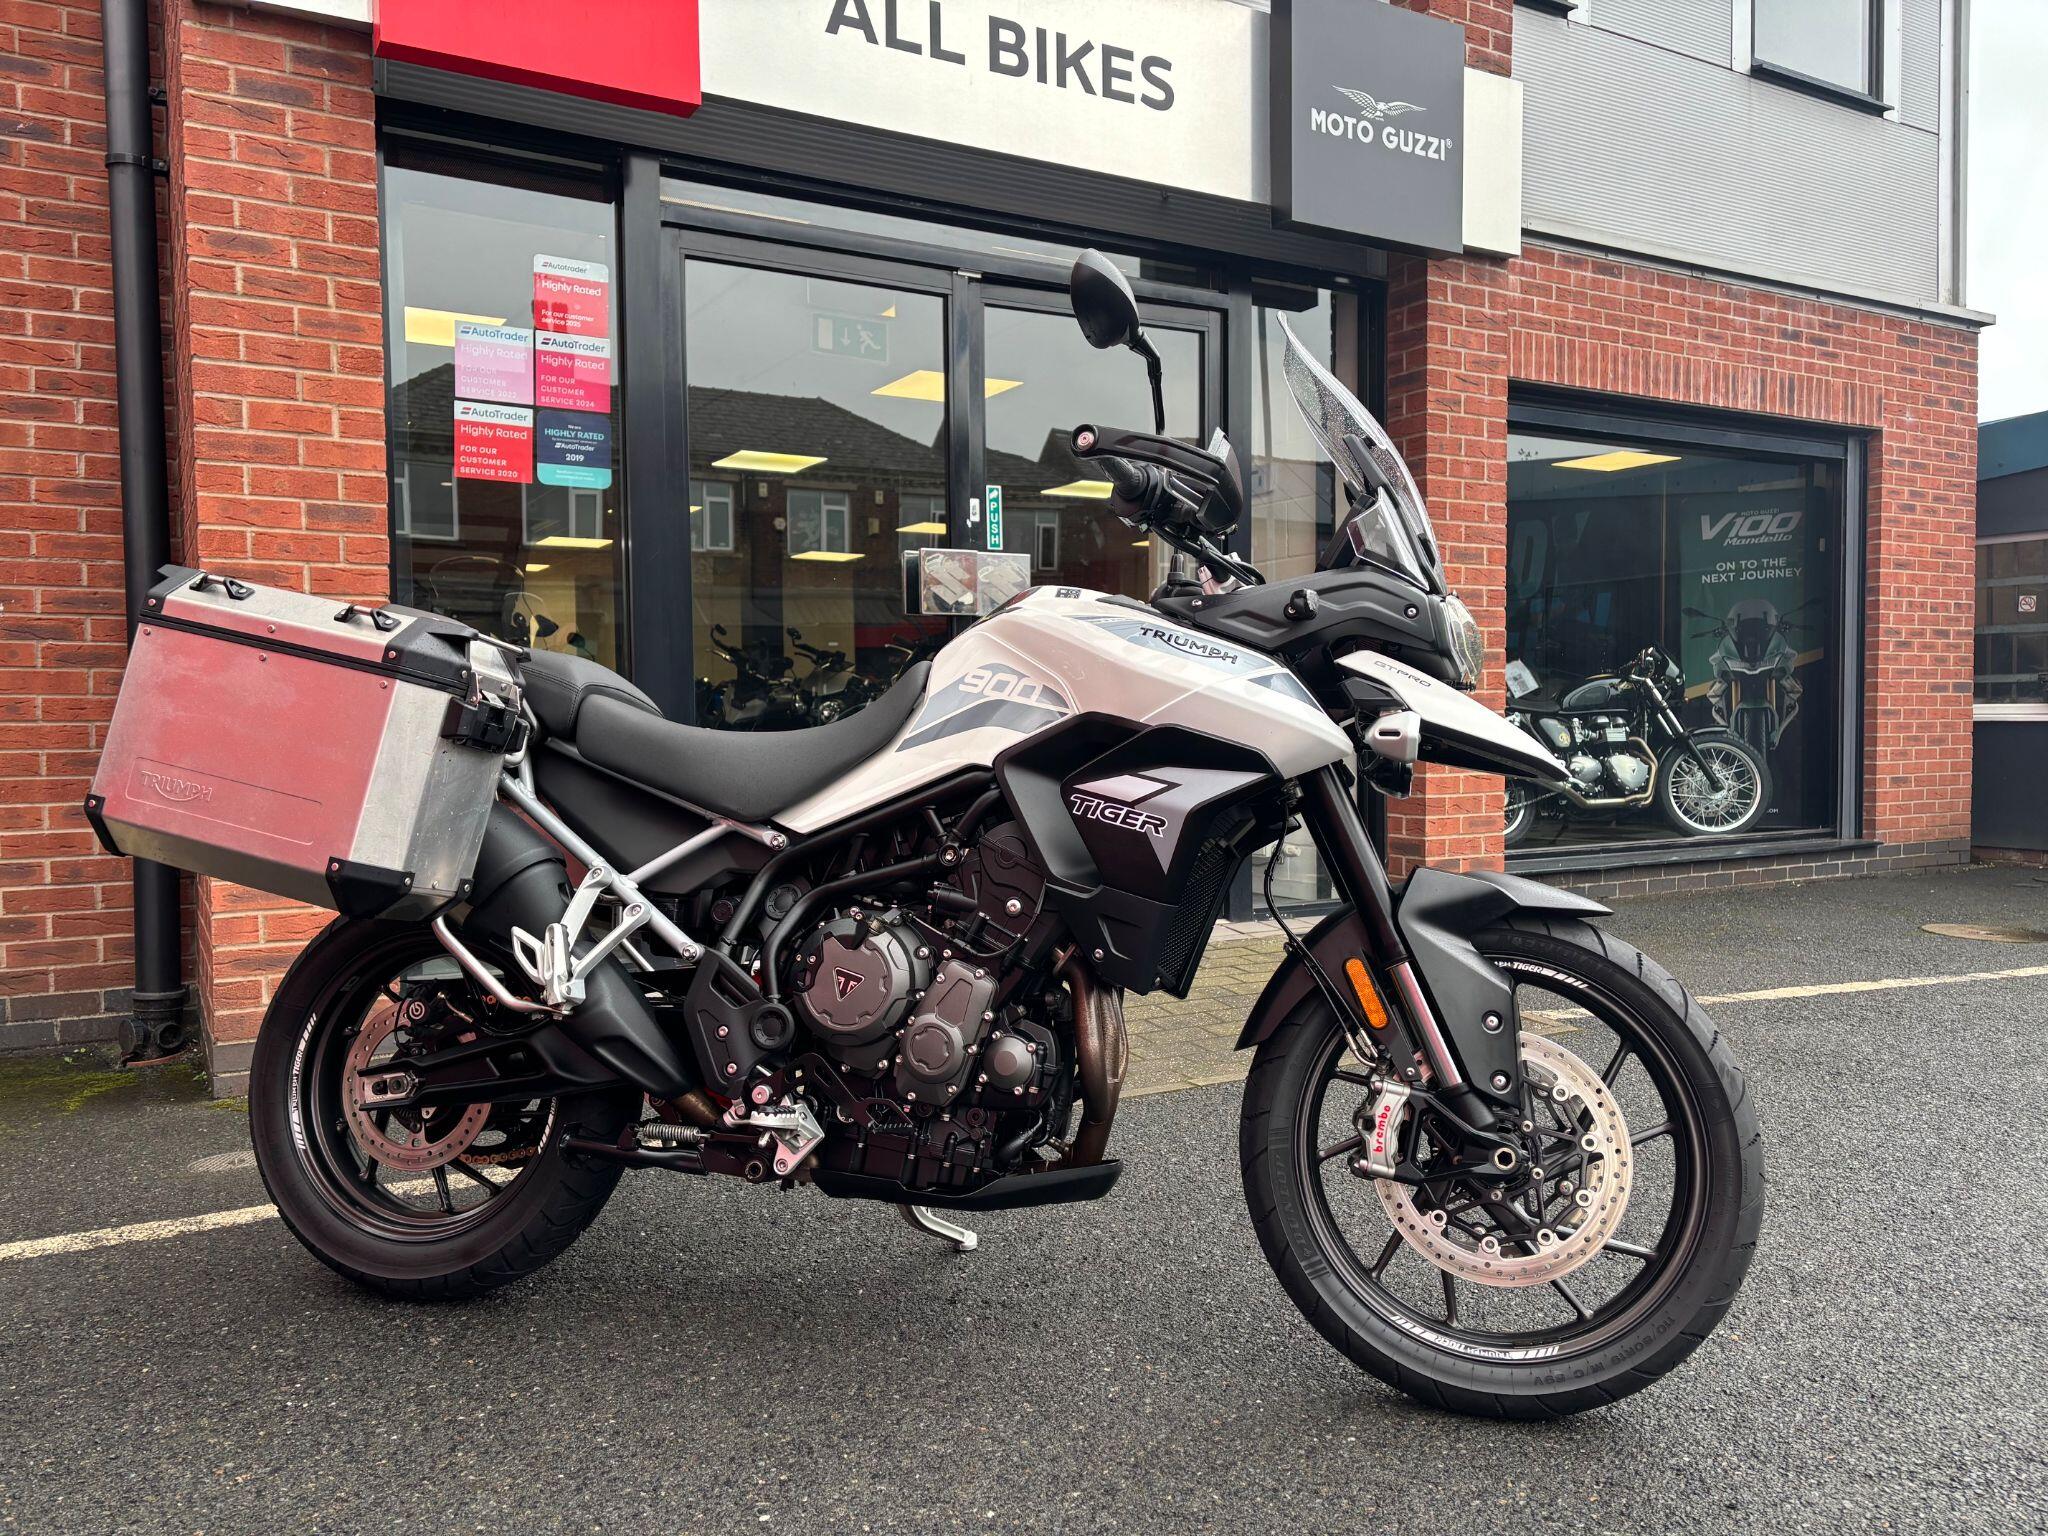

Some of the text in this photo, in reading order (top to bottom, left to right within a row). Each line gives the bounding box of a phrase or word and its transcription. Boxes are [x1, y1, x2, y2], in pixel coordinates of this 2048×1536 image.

[825, 0, 1175, 111] ALL BIKES
[1311, 107, 1374, 143] MOTO
[548, 262, 587, 274] Autotrader
[541, 280, 602, 297] Highly Rated
[541, 317, 566, 326] service
[564, 313, 594, 322] customer
[471, 327, 528, 342] AutoTrader
[461, 343, 528, 361] Highly Rated
[551, 338, 606, 353] AutoTrader
[541, 354, 605, 370] Highly Rated
[460, 375, 507, 387] CUSTOMER
[540, 374, 576, 385] FOR OUR
[540, 385, 585, 396] CUSTOMER
[540, 395, 595, 408] SERVICE 2024
[471, 407, 529, 422] AutoTrader
[460, 424, 528, 440] Highly Rated
[544, 428, 577, 438] HIGHLY
[577, 431, 605, 441] RATED
[460, 444, 498, 455] FOR OUR
[560, 442, 596, 453] AutoTrader
[459, 455, 508, 467] CUSTOMER
[565, 453, 585, 462] 2019
[459, 466, 519, 479] SERVICE 2020
[989, 501, 1000, 545] PUSH
[1700, 511, 1802, 541] V100
[1723, 533, 1793, 547] Mandello
[1715, 556, 1787, 573] ON TO THE
[1701, 567, 1803, 584] NEXT JOURNEY
[1139, 626, 1239, 665] TRIUMPH
[958, 668, 1043, 704] 900
[141, 770, 213, 802] TRIUMPH
[1070, 793, 1168, 838] TIGER
[1512, 960, 1543, 974] TIGER
[292, 1049, 304, 1075] TIGER
[291, 1076, 299, 1113] TRIUMPH
[1372, 1105, 1391, 1153] brembo
[1435, 1335, 1511, 1360] TRIUMPH TIGER
